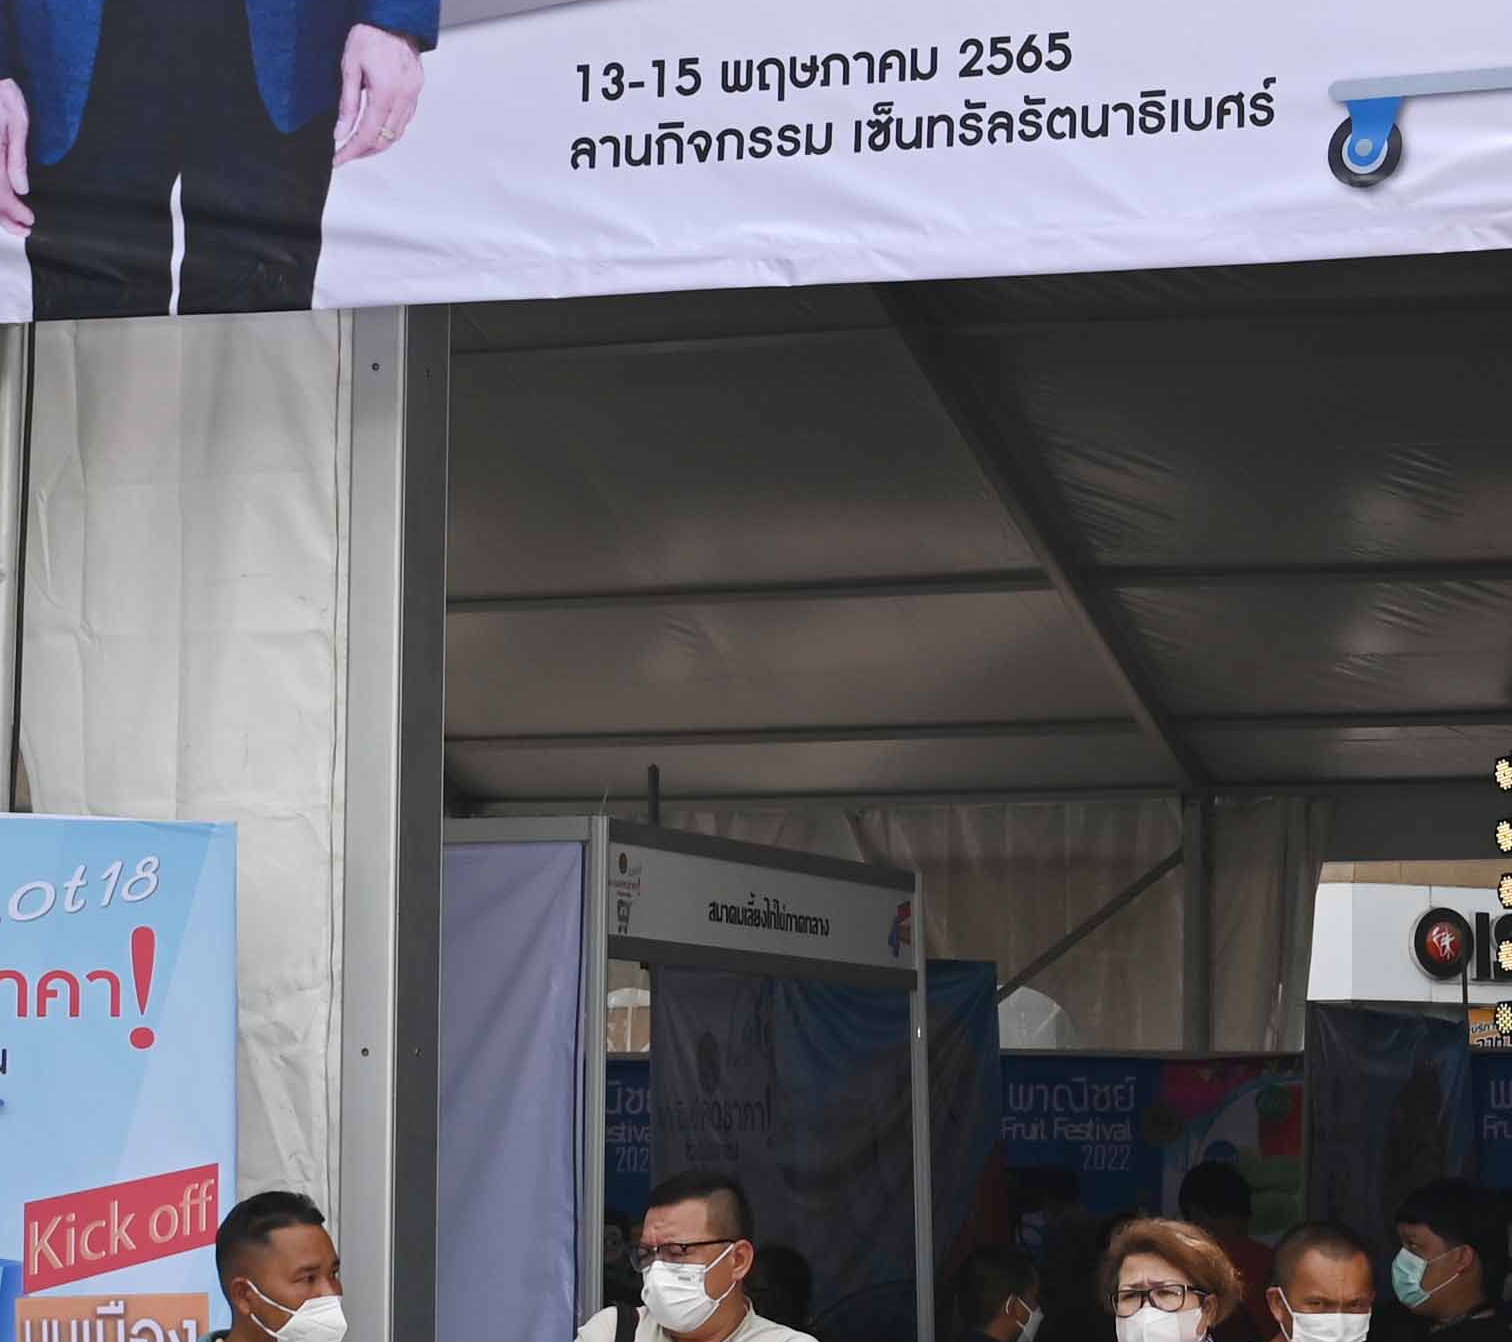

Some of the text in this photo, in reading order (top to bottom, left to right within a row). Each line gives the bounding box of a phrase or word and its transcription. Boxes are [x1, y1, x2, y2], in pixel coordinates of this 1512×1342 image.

[576, 32, 1073, 103] 13-15 พฤษภาคม 2565
[568, 75, 1278, 170] ลานกิจกรรม เซ็นทรัลรัตนาธิเบศร์
[1007, 1075, 1137, 1112] พาณิชย์
[999, 1117, 1135, 1141] Fruit Festival
[1080, 1144, 1132, 1171] 2022
[28, 1178, 215, 1276] Kick off
